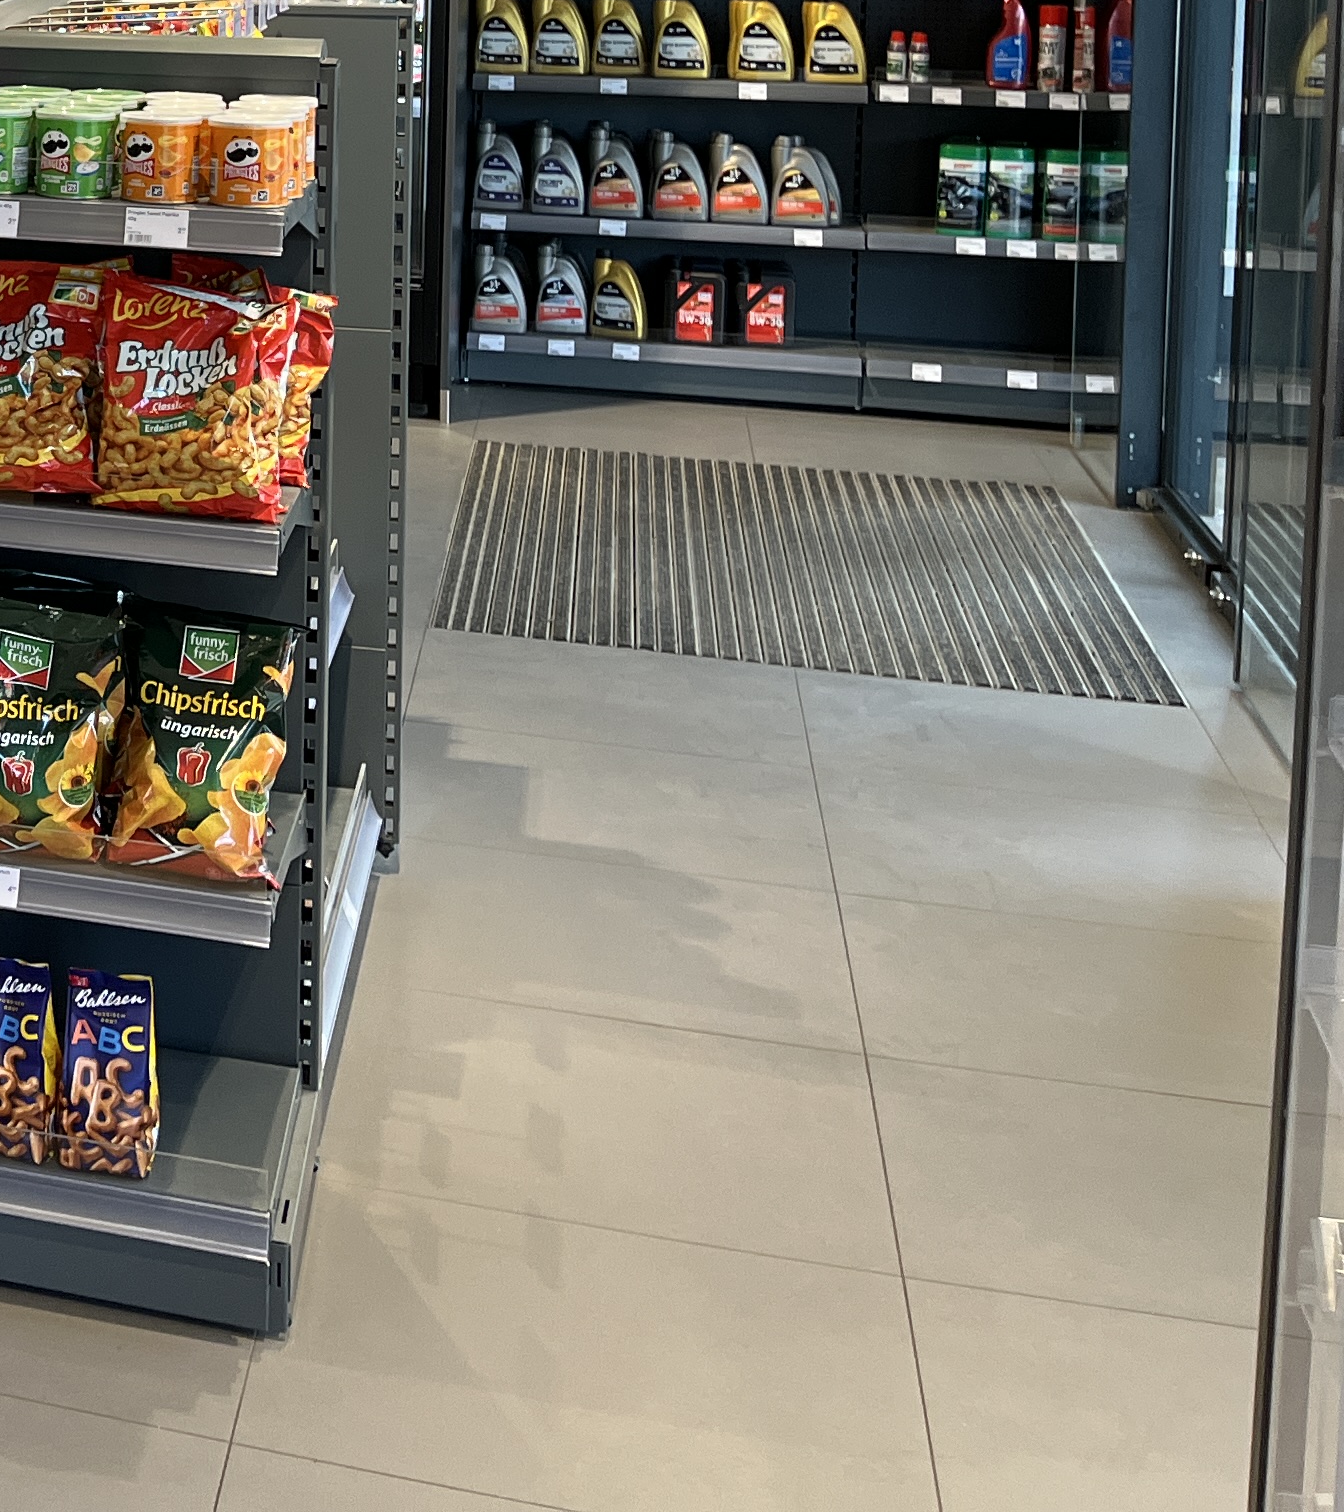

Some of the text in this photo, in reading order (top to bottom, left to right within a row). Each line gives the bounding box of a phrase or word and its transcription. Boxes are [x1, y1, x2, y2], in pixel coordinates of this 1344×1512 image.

[40, 156, 70, 174] PRINGLES
[124, 159, 156, 178] PRINGLES
[223, 163, 261, 181] PRINGLES
[113, 289, 209, 325] Lorenz
[116, 337, 226, 375] Erdnuß
[143, 356, 238, 399] Locken
[143, 417, 189, 435] Erdnüssen
[2, 634, 43, 655] funny-
[190, 632, 230, 651] funny-
[5, 647, 44, 667] frisch
[193, 644, 229, 663] frisch
[140, 681, 266, 721] Chipsfrisch
[160, 717, 239, 741] ungarisch
[74, 988, 147, 1008] Bahlsen
[70, 1019, 146, 1055] ABC
